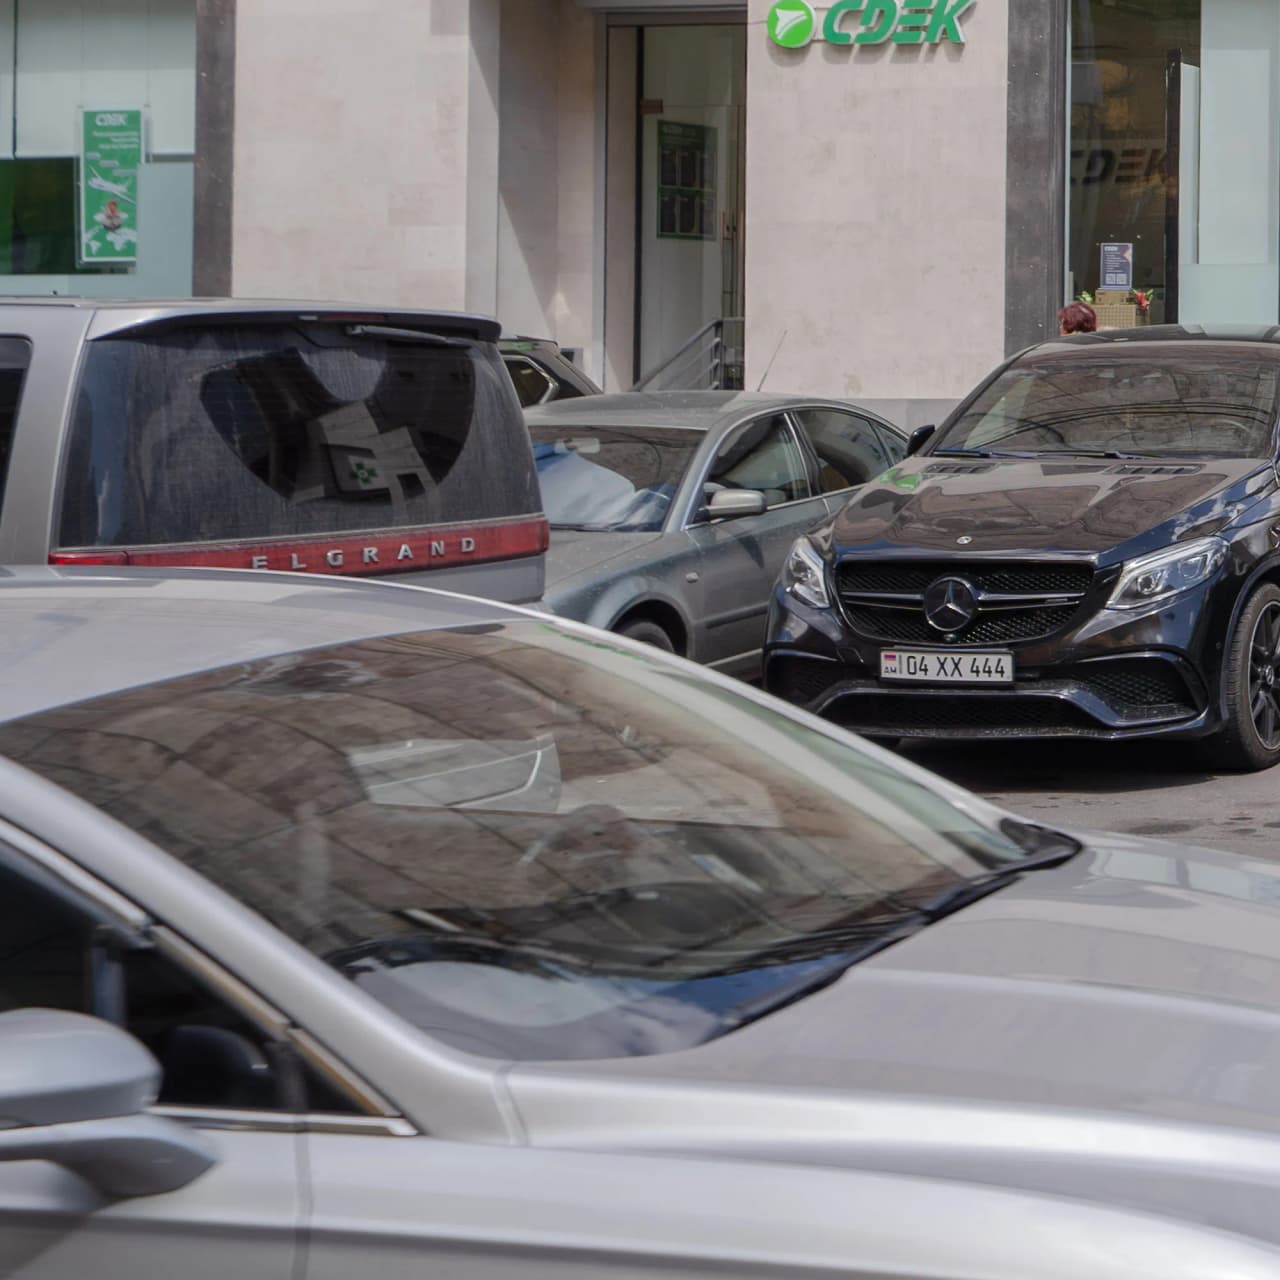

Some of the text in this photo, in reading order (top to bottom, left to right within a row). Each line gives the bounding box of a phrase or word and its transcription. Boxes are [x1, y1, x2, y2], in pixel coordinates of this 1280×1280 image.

[252, 536, 476, 570] ELGRAND
[906, 655, 1005, 678] 04 XX 444
